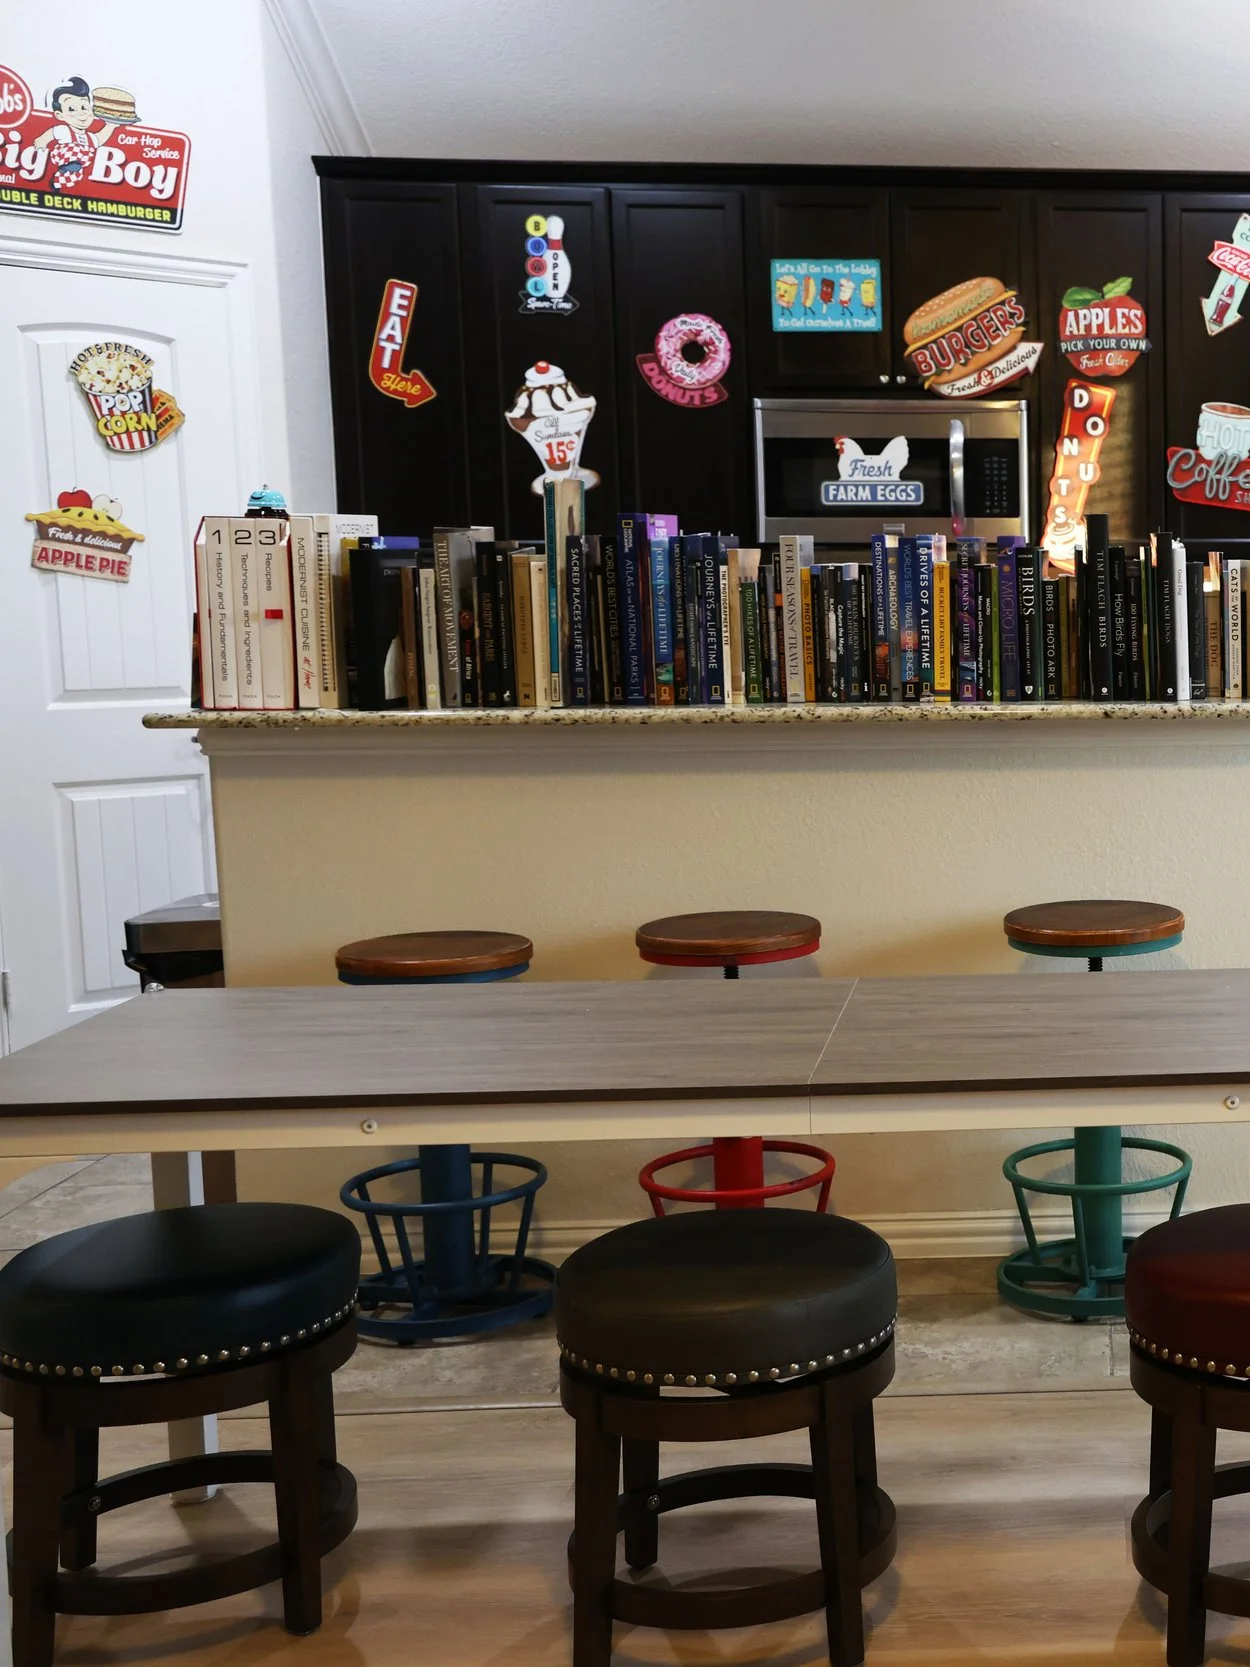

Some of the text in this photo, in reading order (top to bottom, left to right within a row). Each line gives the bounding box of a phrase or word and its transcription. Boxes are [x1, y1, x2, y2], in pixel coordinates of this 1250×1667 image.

[0, 83, 23, 114] b's
[118, 134, 162, 148] Car Hop
[143, 148, 180, 160] Service
[0, 130, 178, 200] ig Boy
[1, 189, 171, 222] UBLE DECK HAMBURGER
[809, 264, 820, 273] Go
[822, 264, 833, 273] To
[835, 264, 849, 273] The
[851, 264, 877, 277] Lobby
[378, 286, 413, 369] EAT
[912, 296, 1024, 376] BURGERS
[1065, 307, 1143, 336] APPLES
[70, 348, 92, 372] HOT
[104, 342, 152, 365] FRESH
[1061, 338, 1147, 352] PICK YOUR OWN
[1080, 353, 1129, 369] Fresh Cider
[380, 373, 421, 396] Here
[642, 362, 719, 405] DONUTS
[674, 363, 696, 382] Daily
[947, 378, 979, 395] Fresh
[992, 346, 1038, 379] Delicious
[100, 391, 144, 416] POP
[97, 412, 157, 437] CORN
[848, 457, 893, 478] Fresh
[1054, 388, 1105, 523] DONUTS
[828, 484, 916, 502] FARM EGGS
[48, 526, 74, 542] Fresh
[84, 534, 122, 551] delicious
[212, 529, 221, 545] 1
[234, 530, 252, 545] 2
[259, 530, 276, 545] 3
[36, 547, 129, 577] APPLE PIE
[215, 552, 224, 589] History
[265, 553, 273, 592] Recipes
[570, 548, 580, 585] SACRED
[674, 543, 683, 598] DESTINATIONS
[961, 543, 969, 571] SECRET
[297, 537, 310, 652] MODERNIST CUISINE
[437, 540, 459, 673] THE ART MOVEMENT
[572, 587, 581, 620] PLACES
[651, 546, 668, 655] JOURNEYS LIFETIME
[874, 541, 885, 636] DESTINATIONS LIFETIME
[888, 569, 898, 631] ARCHAEOLOGY
[960, 573, 970, 611] JOURNEYS
[1021, 566, 1035, 616] BIRDS
[1096, 550, 1107, 648] TIM FLACH BIRDS
[1113, 593, 1124, 616] How
[1230, 568, 1239, 641] CATS WORLD
[241, 553, 253, 686] Techniques and Ingredients
[607, 587, 618, 638] BEST CITIES
[624, 560, 639, 683] ATLAS NATIONAL PARKS
[704, 554, 718, 669] JOURNEYS LIFETIME
[721, 583, 729, 634] PHOTOGRAPHER'S
[785, 544, 799, 680] FOUR SEASONS TRAVEL
[836, 605, 844, 627] Capture
[905, 601, 913, 629] TRAVEL
[919, 547, 930, 669] DRIVES OF A LIFETIME
[1001, 580, 1017, 661] MICRO LIFE
[745, 588, 757, 679] 100 HIKES OF LIFETIME
[852, 621, 860, 660] JOURNEYS
[962, 623, 970, 657] LIFETIME
[1045, 585, 1056, 679] BIRDS PHOTO ARK
[1115, 617, 1126, 641] Birds
[1130, 616, 1138, 640] FLYING
[1210, 620, 1219, 668] THE DOG
[219, 613, 228, 682] Fundamentals
[574, 630, 584, 673] LIFETIME
[805, 635, 813, 666] BASICS
[905, 630, 914, 681] EXPERIENCES
[1113, 643, 1126, 657] Fly
